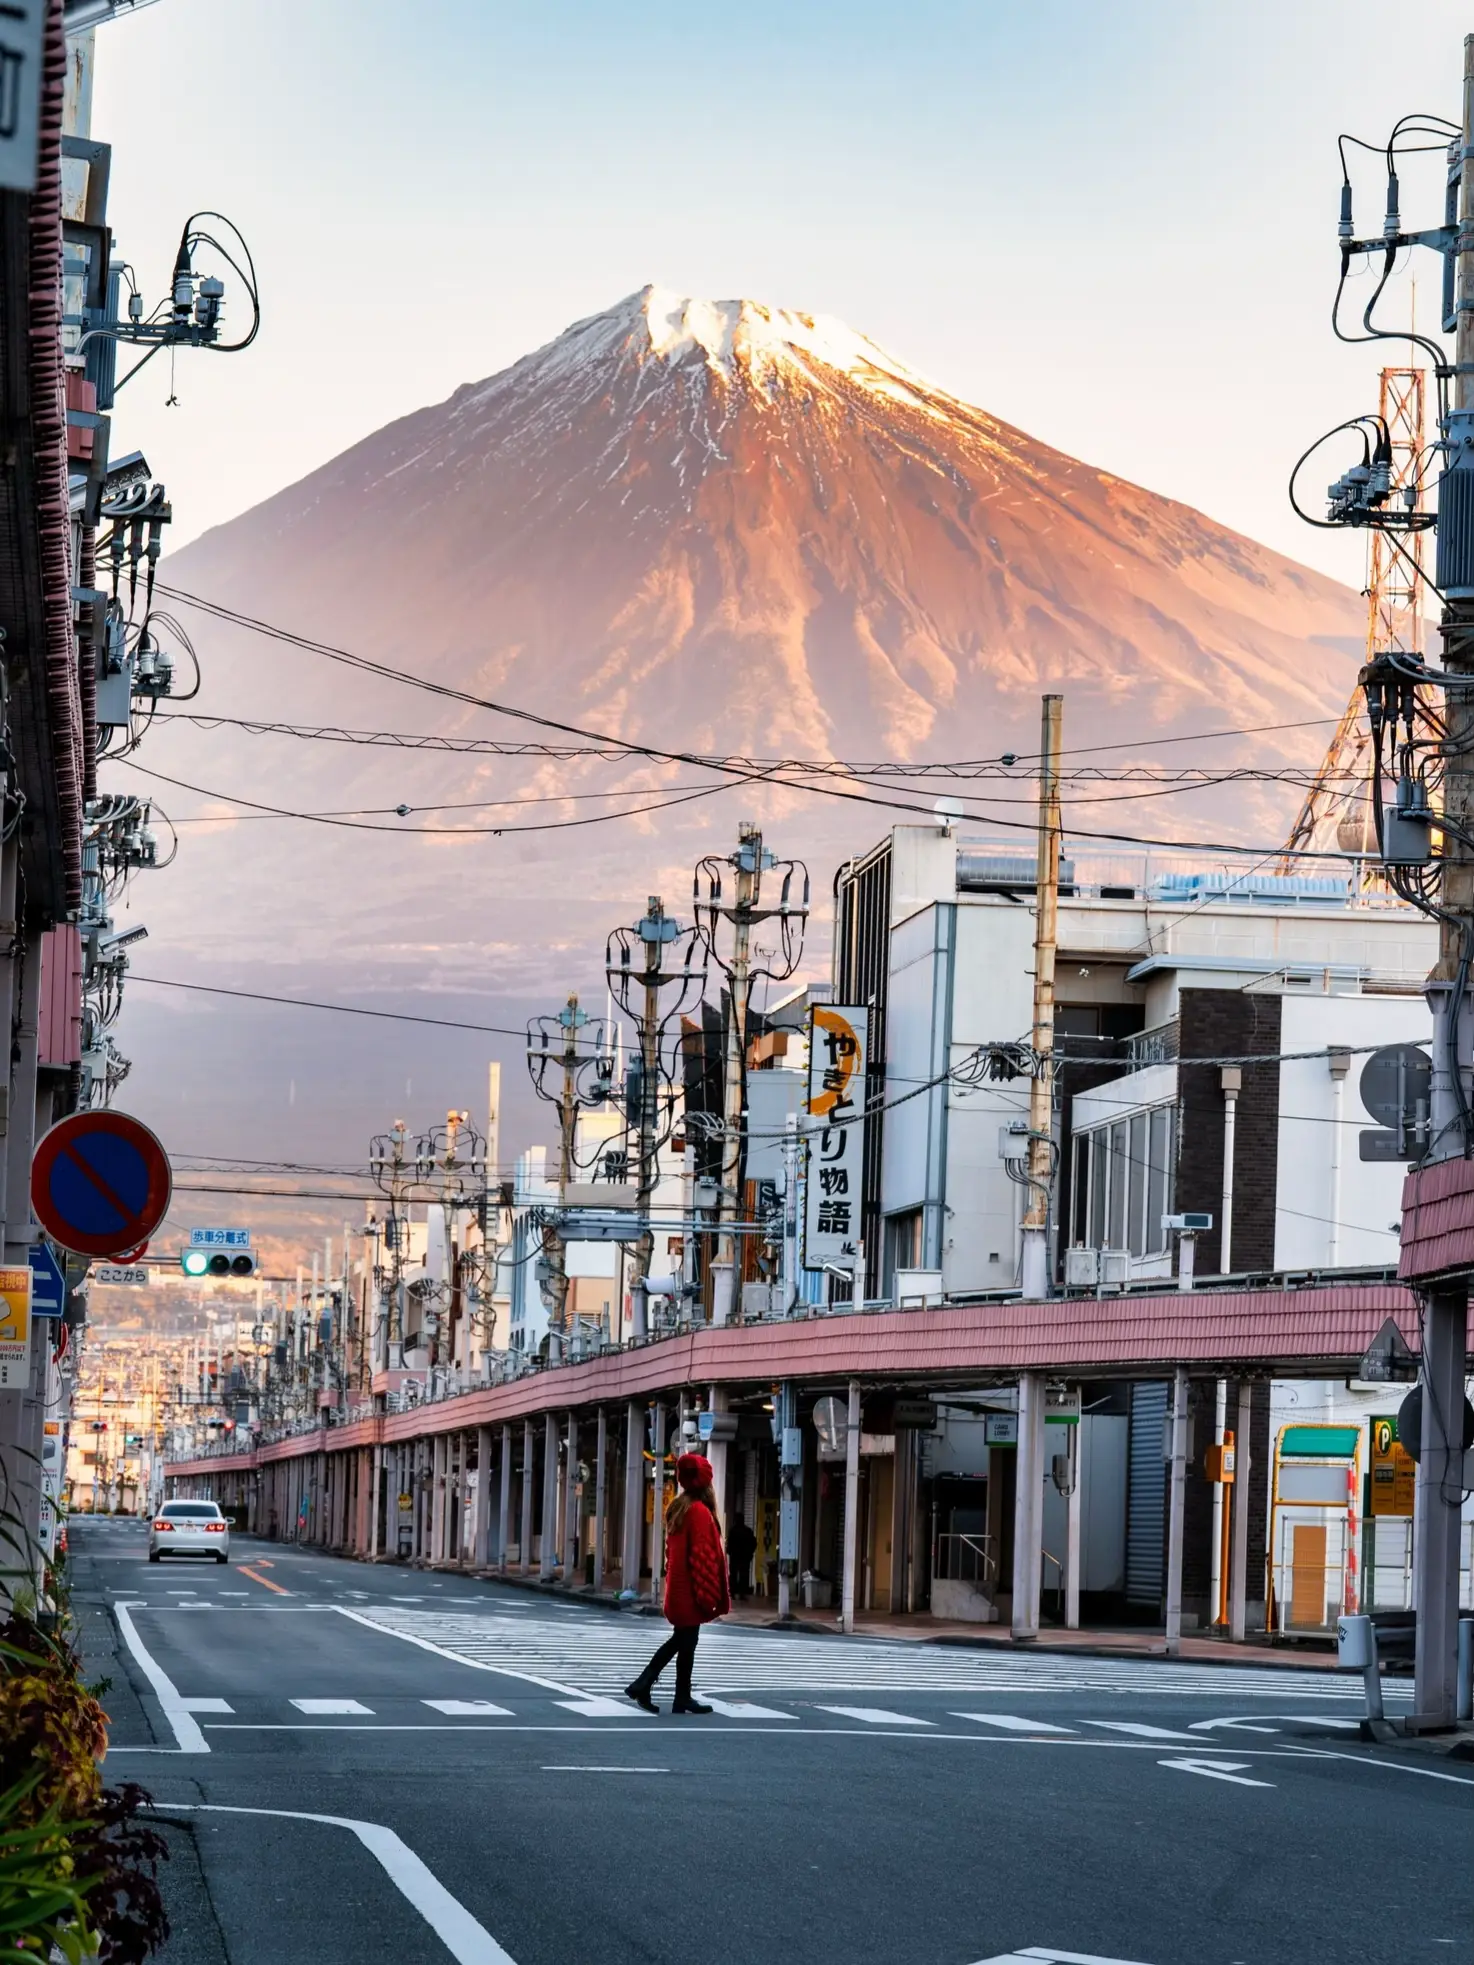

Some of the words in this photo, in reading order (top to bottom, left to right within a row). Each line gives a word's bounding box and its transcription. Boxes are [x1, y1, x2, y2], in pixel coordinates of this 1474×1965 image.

[817, 1031, 856, 1235] やきとり物語
[192, 1231, 247, 1244] 歩車分離式
[100, 1269, 146, 1282] ここから
[1381, 1428, 1390, 1451] P
